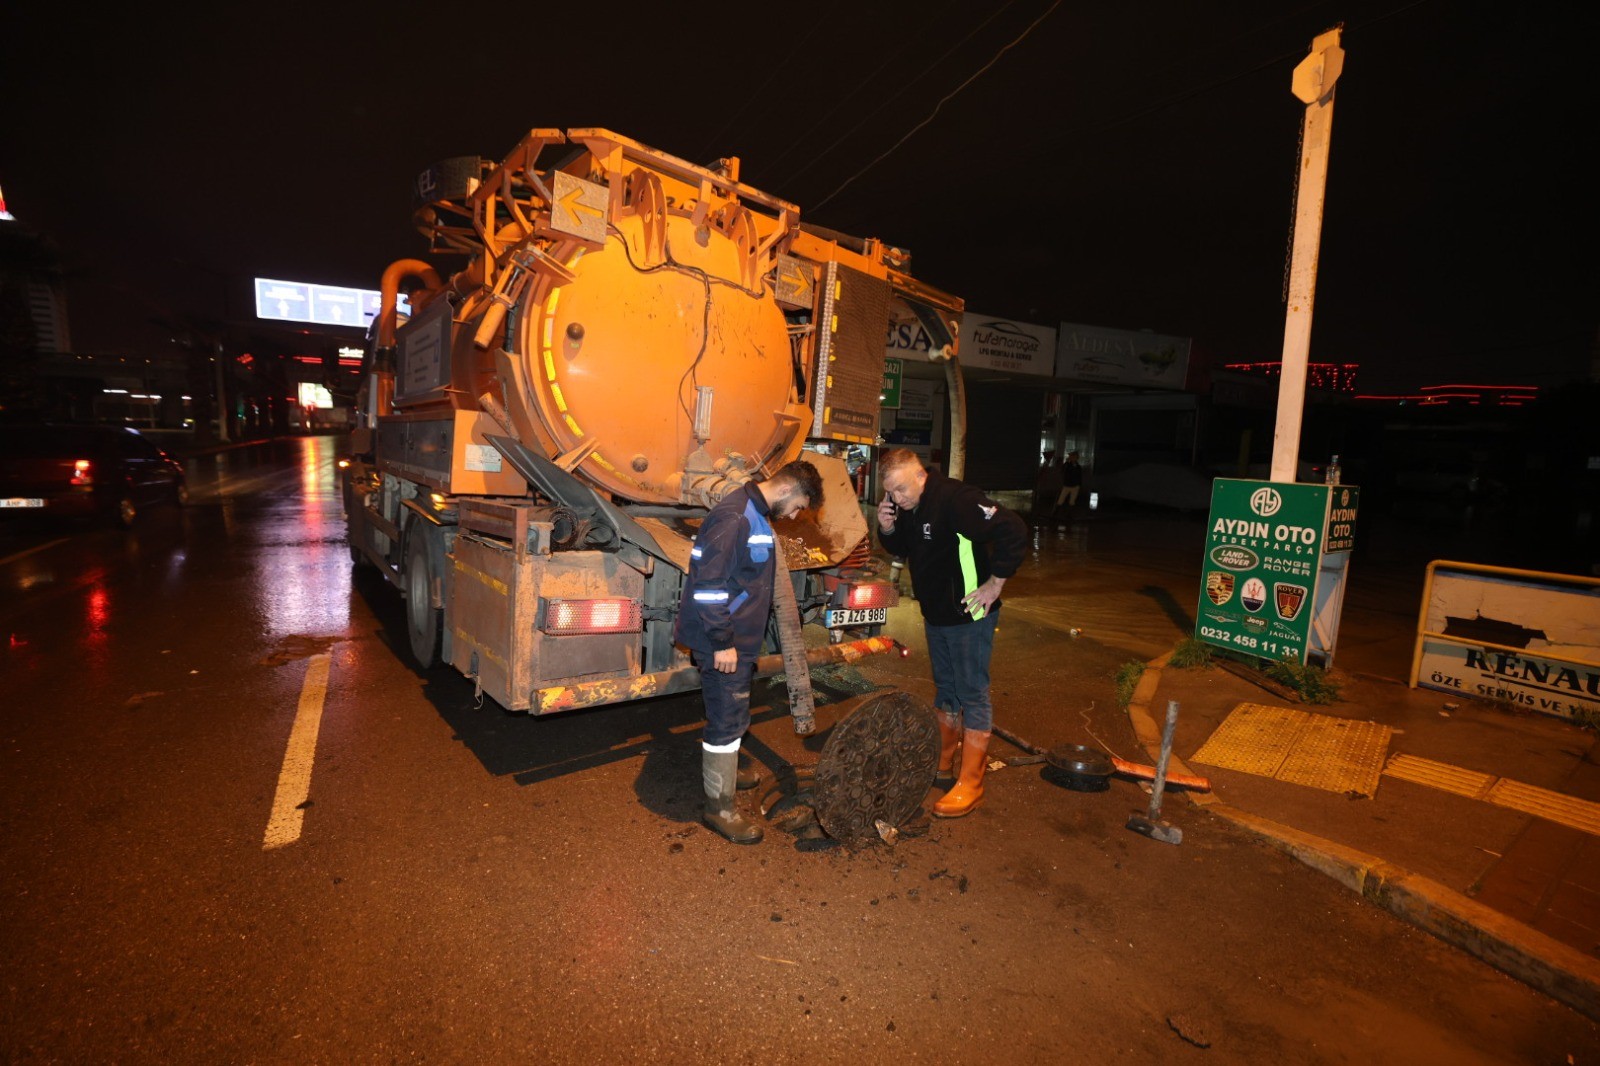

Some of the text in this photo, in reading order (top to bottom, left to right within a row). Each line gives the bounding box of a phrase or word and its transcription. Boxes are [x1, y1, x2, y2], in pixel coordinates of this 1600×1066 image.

[1331, 508, 1356, 522] AYDIN
[1213, 518, 1316, 545] AYDIN OTO
[1333, 524, 1350, 538] OTO
[1213, 534, 1314, 556] YEDEK PARÇA
[1264, 556, 1312, 570] RANGE
[1264, 564, 1312, 577] ROVER
[1278, 586, 1303, 595] ROVER
[833, 608, 885, 624] 35 AZG 988
[1246, 616, 1265, 626] Jeep
[1201, 626, 1230, 642] 0232
[1233, 635, 1257, 649] 458
[1262, 641, 1276, 654] 11
[1269, 630, 1301, 643] JAGUAR
[1431, 671, 1462, 689] ÖZE
[1540, 697, 1562, 713] VE
